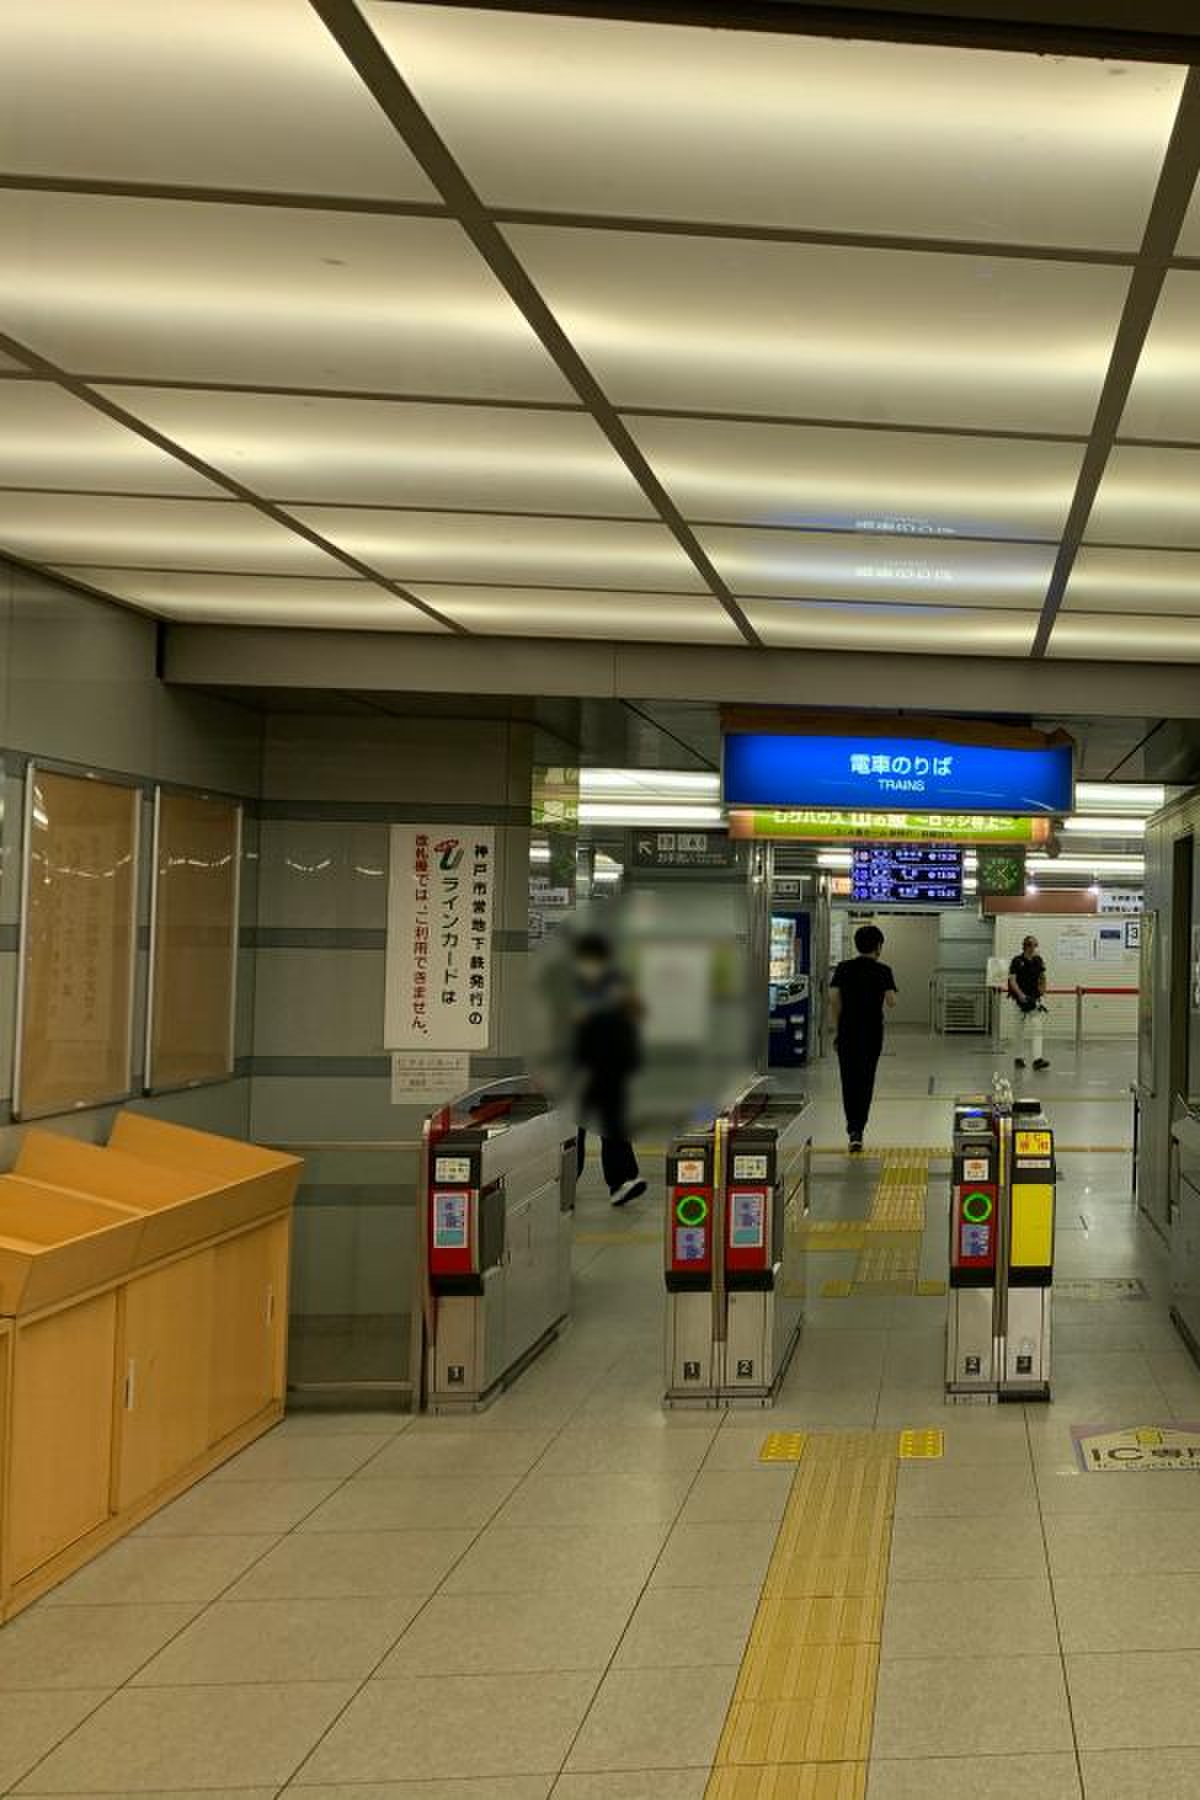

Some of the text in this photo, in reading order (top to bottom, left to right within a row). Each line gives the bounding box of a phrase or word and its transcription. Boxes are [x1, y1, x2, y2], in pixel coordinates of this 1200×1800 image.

[850, 754, 953, 776] 電車のりば
[878, 779, 925, 792] TRAINS
[468, 844, 489, 1026] 神戸市営地下鉄発行の
